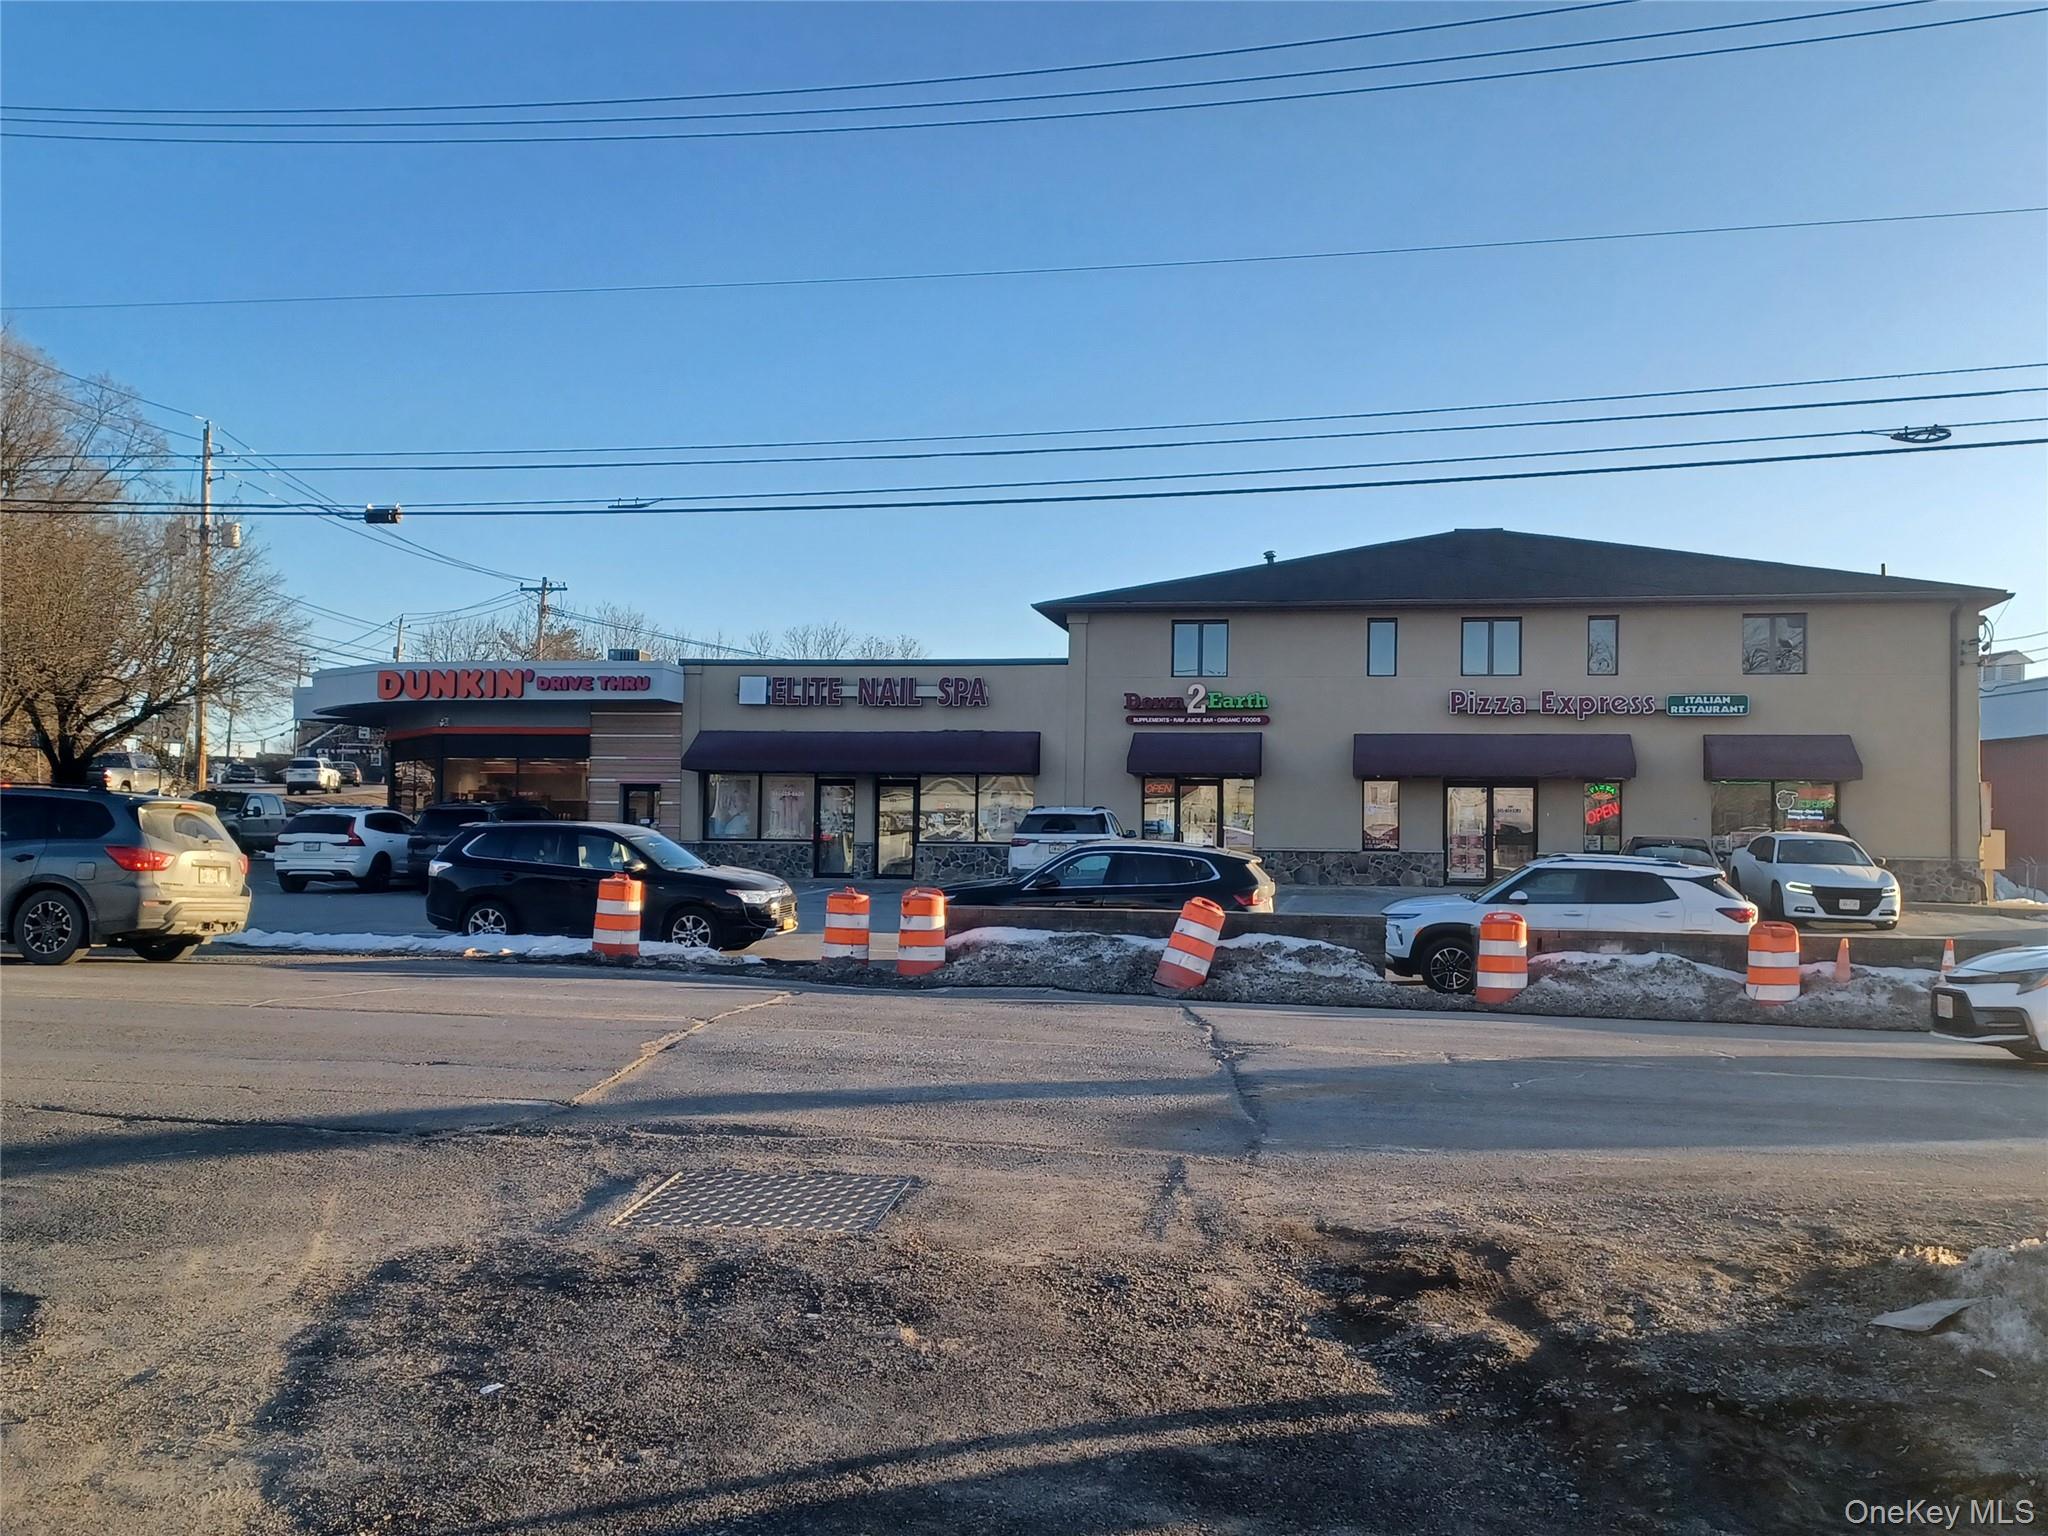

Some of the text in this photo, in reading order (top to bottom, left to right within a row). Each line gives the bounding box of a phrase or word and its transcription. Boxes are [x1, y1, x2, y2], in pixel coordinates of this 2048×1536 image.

[377, 668, 651, 700] DUNKIN' DRIVE THRU
[770, 676, 988, 707] ELITE NAIL SPA
[1124, 683, 1269, 714] Down 2 Earth
[1449, 689, 1656, 721] Pizza Express
[1670, 705, 1745, 714] RESTAURANT
[1684, 696, 1731, 704] ITALIAN
[1146, 783, 1173, 795] OPEN
[1587, 801, 1620, 824] OPEN
